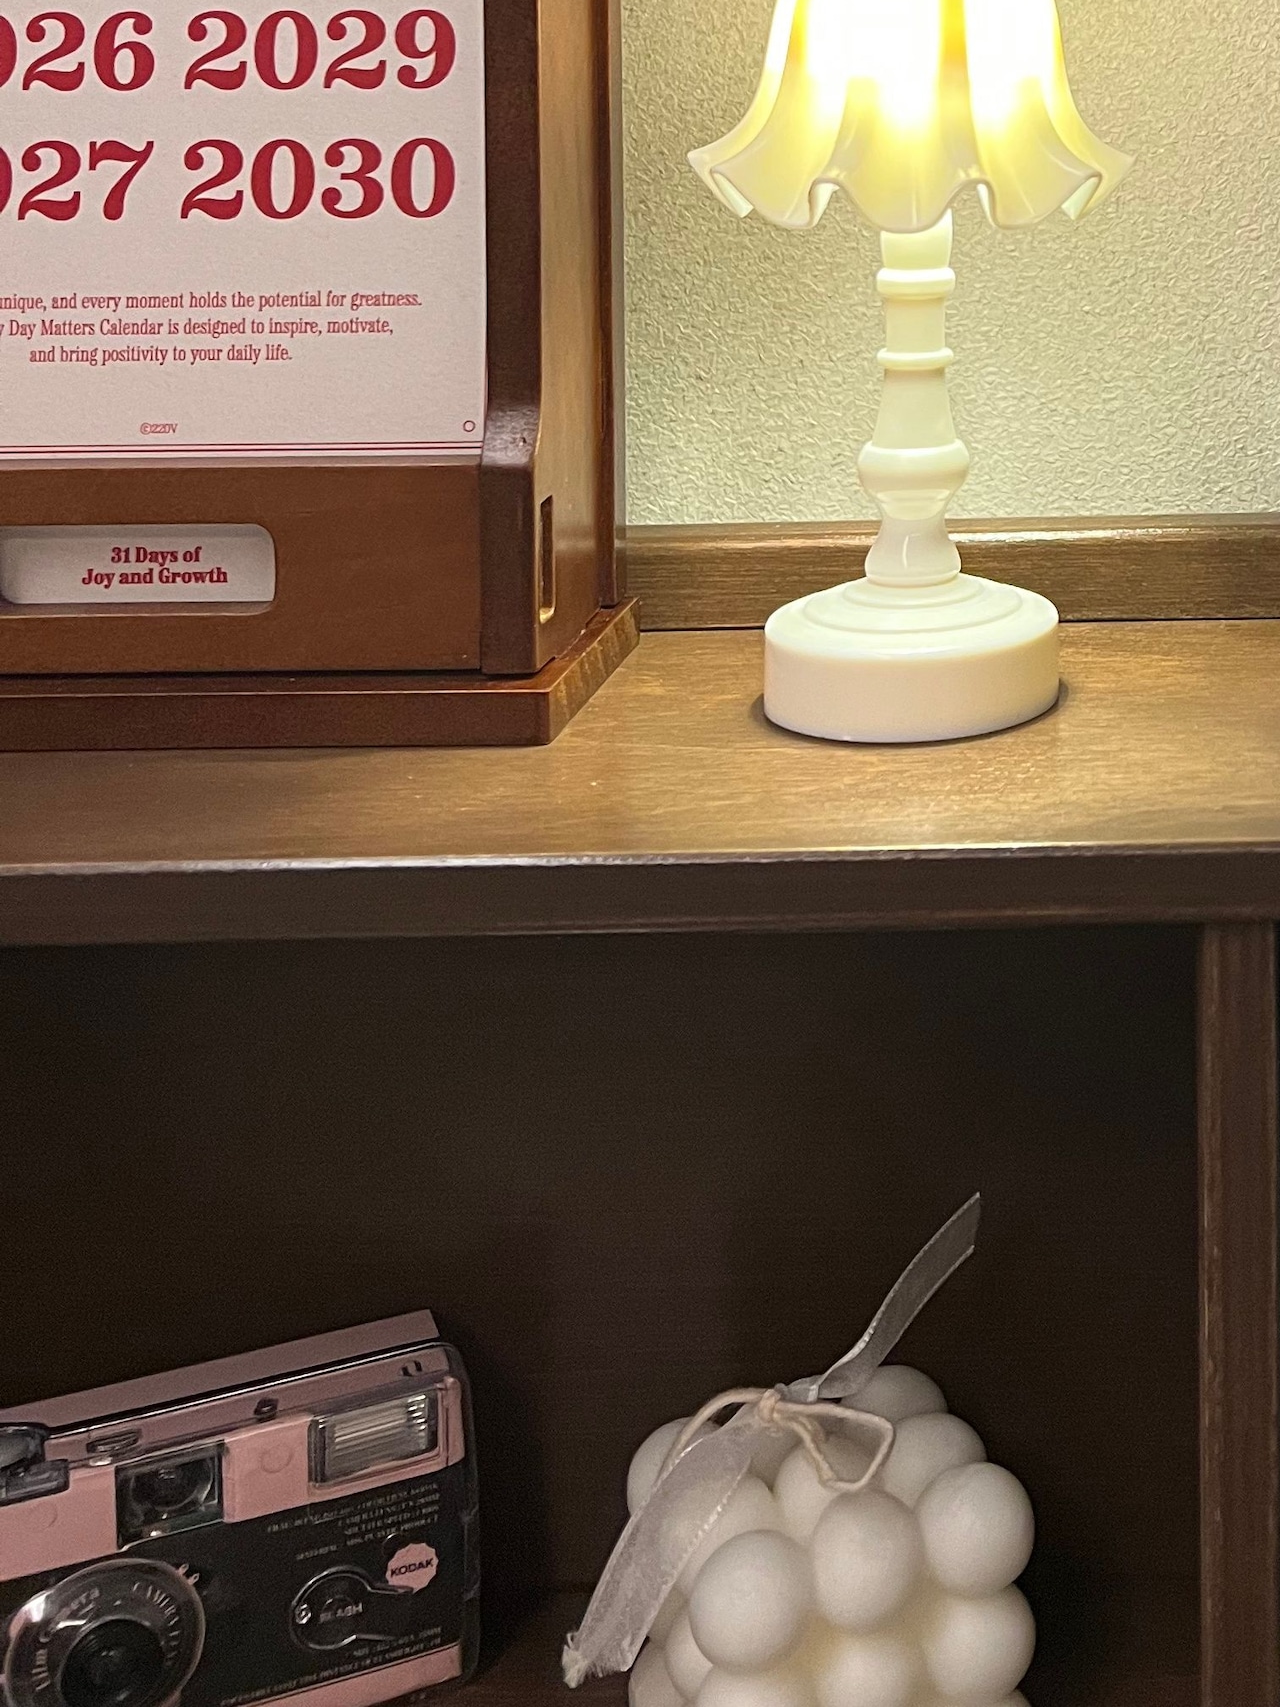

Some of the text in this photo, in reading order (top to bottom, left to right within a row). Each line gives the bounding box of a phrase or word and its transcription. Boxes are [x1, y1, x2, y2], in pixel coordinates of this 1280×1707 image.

[0, 10, 455, 91] 26 2029
[0, 138, 455, 221] 27 2030
[0, 290, 422, 313] nique, and every moment holds the potential for greatness.
[9, 319, 36, 340] Day
[41, 319, 95, 335] Matters
[100, 318, 163, 335] Calendar
[168, 319, 179, 334] is
[184, 318, 245, 338] designed
[251, 320, 264, 334] to
[269, 318, 322, 338] inspire,
[327, 317, 393, 334] motivate,
[30, 344, 292, 366] and bring positivity to your daily life.
[111, 546, 202, 567] 31 Days of
[82, 567, 227, 589] Joy and Growth
[390, 1557, 435, 1578] KODAK
